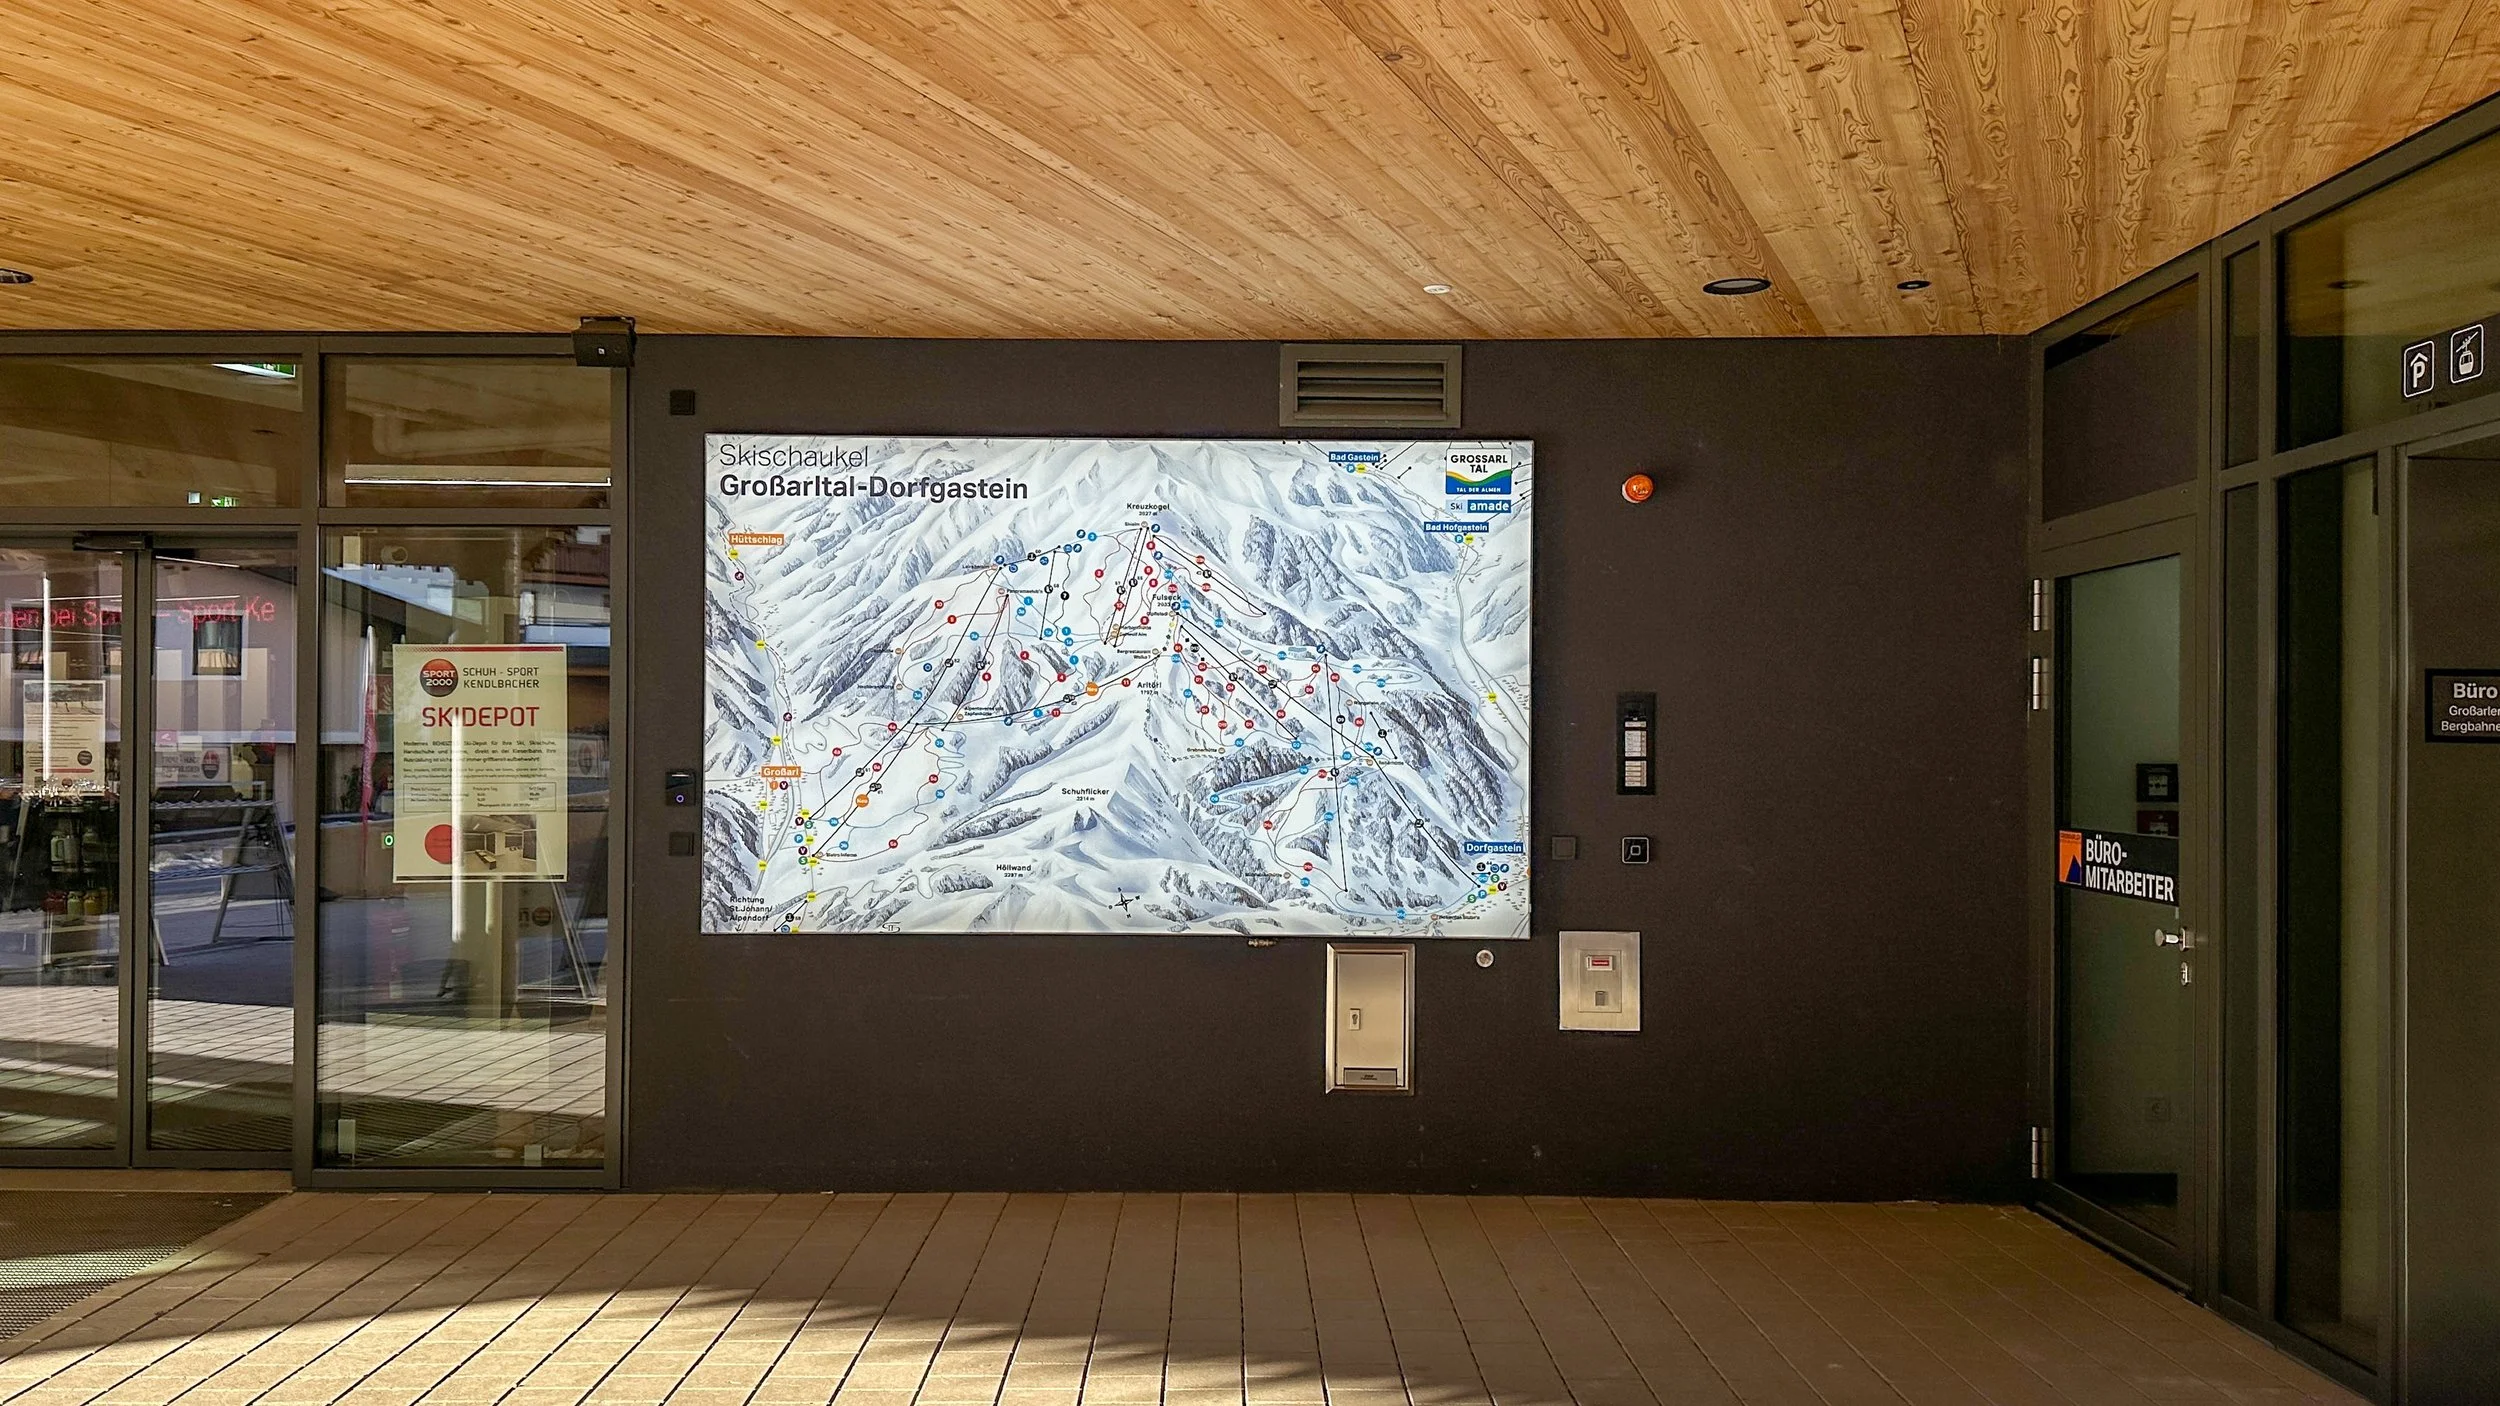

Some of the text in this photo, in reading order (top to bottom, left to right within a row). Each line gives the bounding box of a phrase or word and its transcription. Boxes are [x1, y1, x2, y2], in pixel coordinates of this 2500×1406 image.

[719, 443, 869, 467] Skischaukel
[1450, 454, 1508, 464] GROSSARL
[1470, 464, 1488, 473] TAL
[719, 474, 1029, 502] Großarltal-Dorfgastein
[1126, 503, 1170, 511] Kreuzkogel
[1450, 502, 1463, 510] Ski
[1425, 523, 1488, 532] Bad Hofgastein
[731, 535, 783, 546] Hüttschlag
[463, 668, 496, 676] SCHUH
[507, 668, 539, 676] SPORT
[464, 680, 540, 688] KENDLBACHER
[2453, 682, 2498, 699] Büro
[763, 768, 799, 776] Großarl
[1466, 844, 1522, 853] Dorfgastein
[2085, 834, 2128, 866] BÜRO-
[2085, 864, 2175, 902] MITARBEITER
